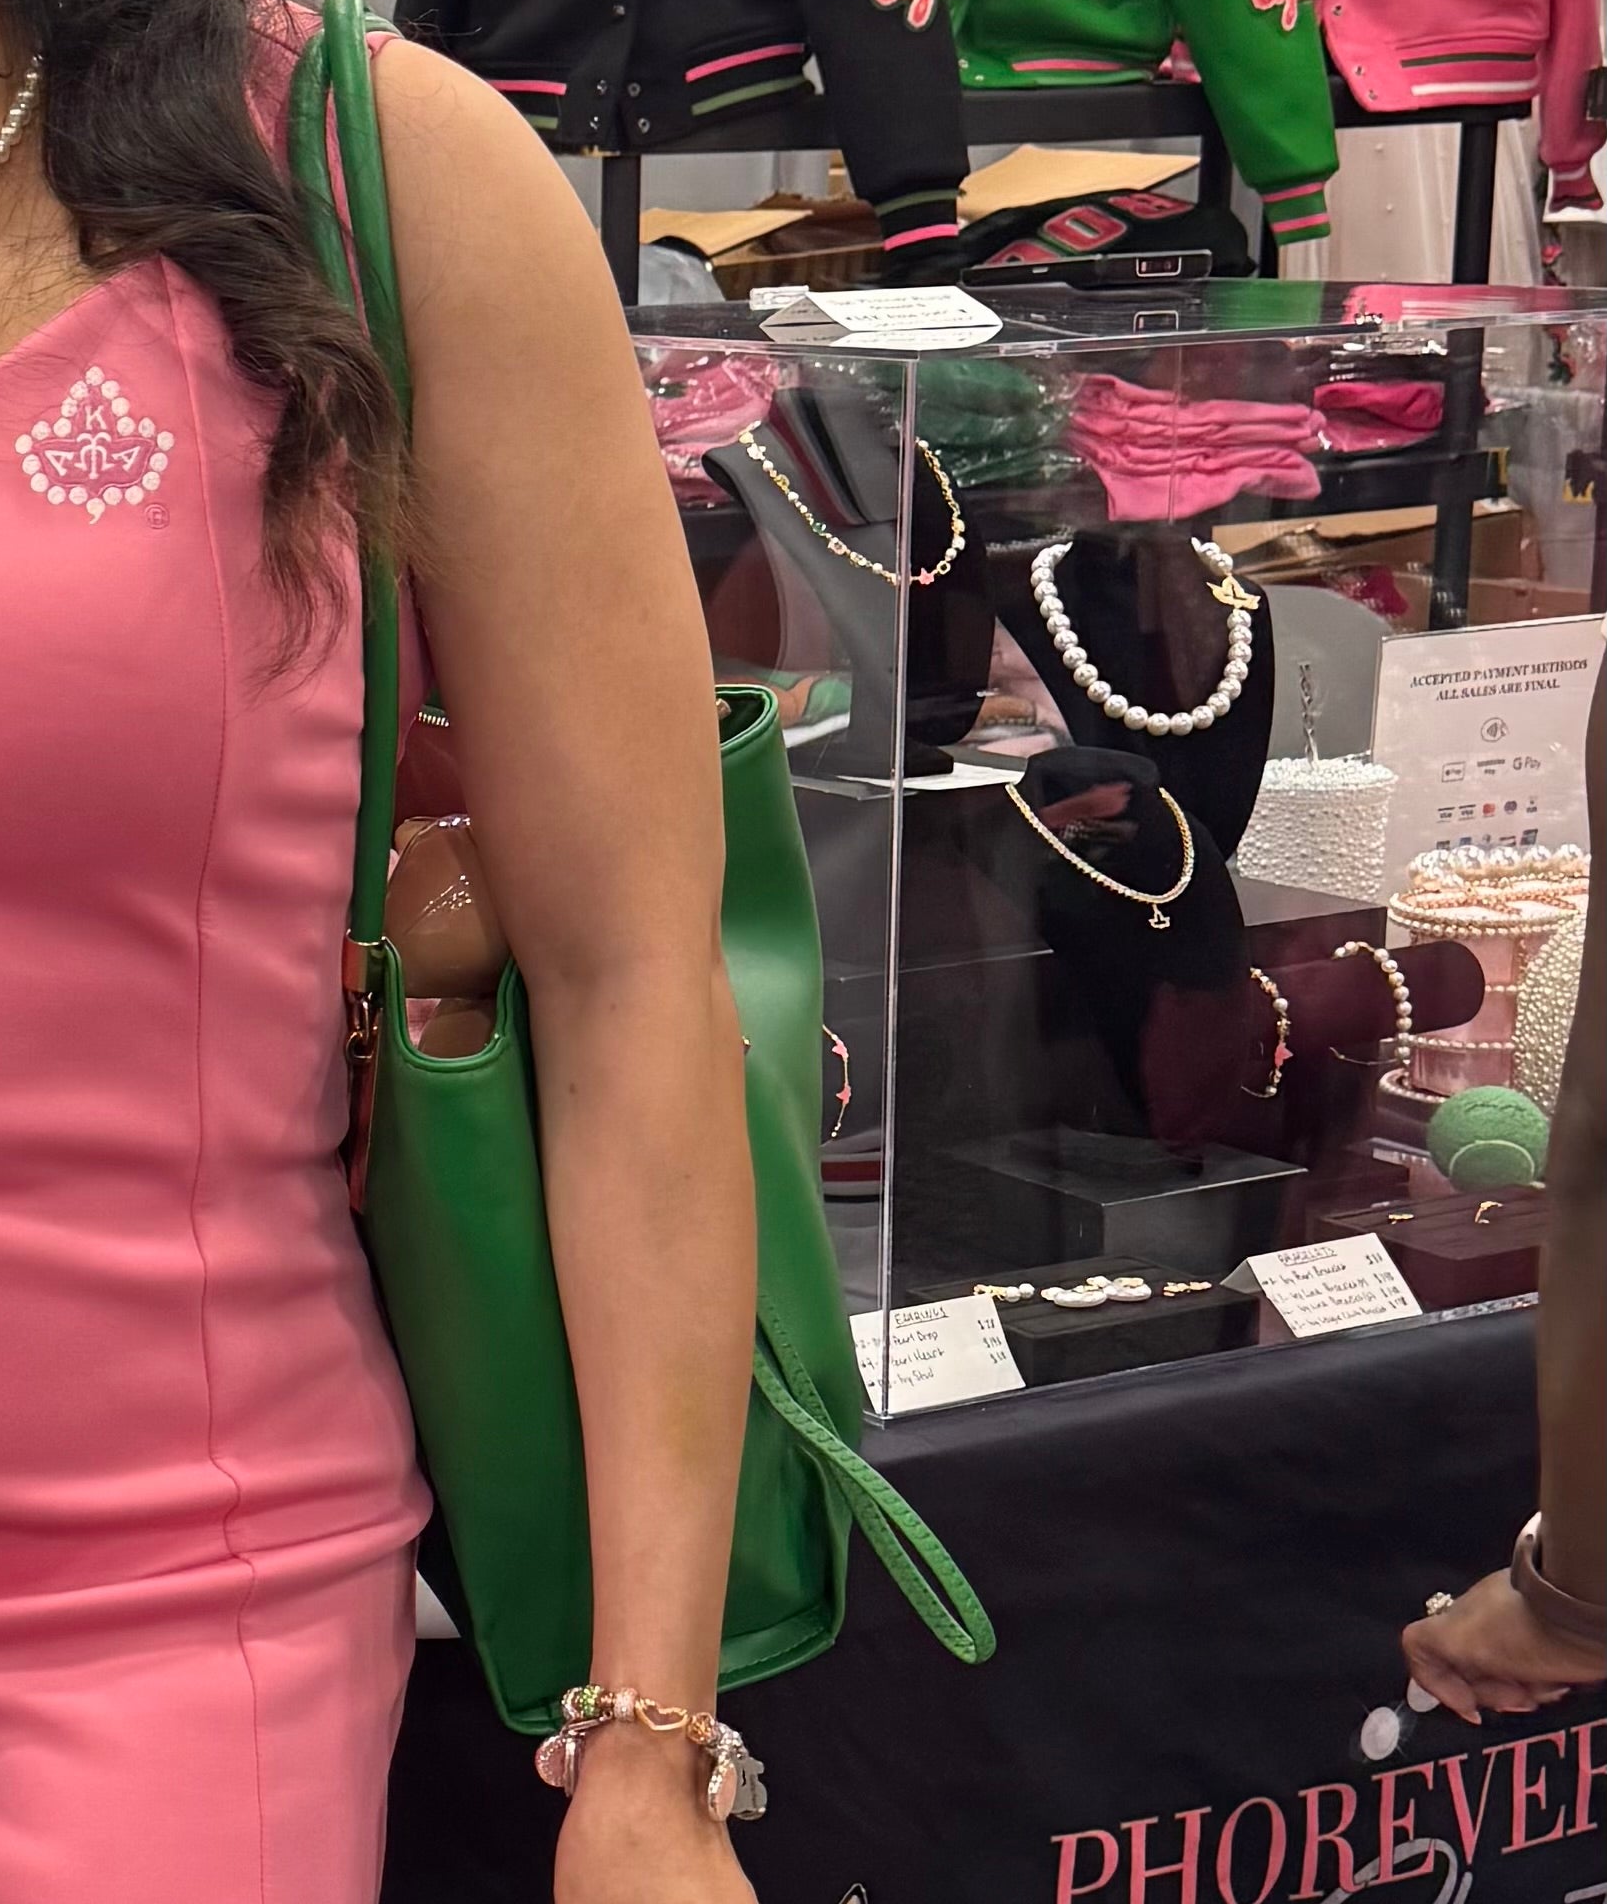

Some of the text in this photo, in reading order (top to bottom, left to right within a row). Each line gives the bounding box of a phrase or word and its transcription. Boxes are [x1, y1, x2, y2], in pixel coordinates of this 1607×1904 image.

[1410, 659, 1588, 689] ACCEPTED PAYMENT METHODS
[1436, 678, 1561, 701] ALL SALES ARE FINAL
